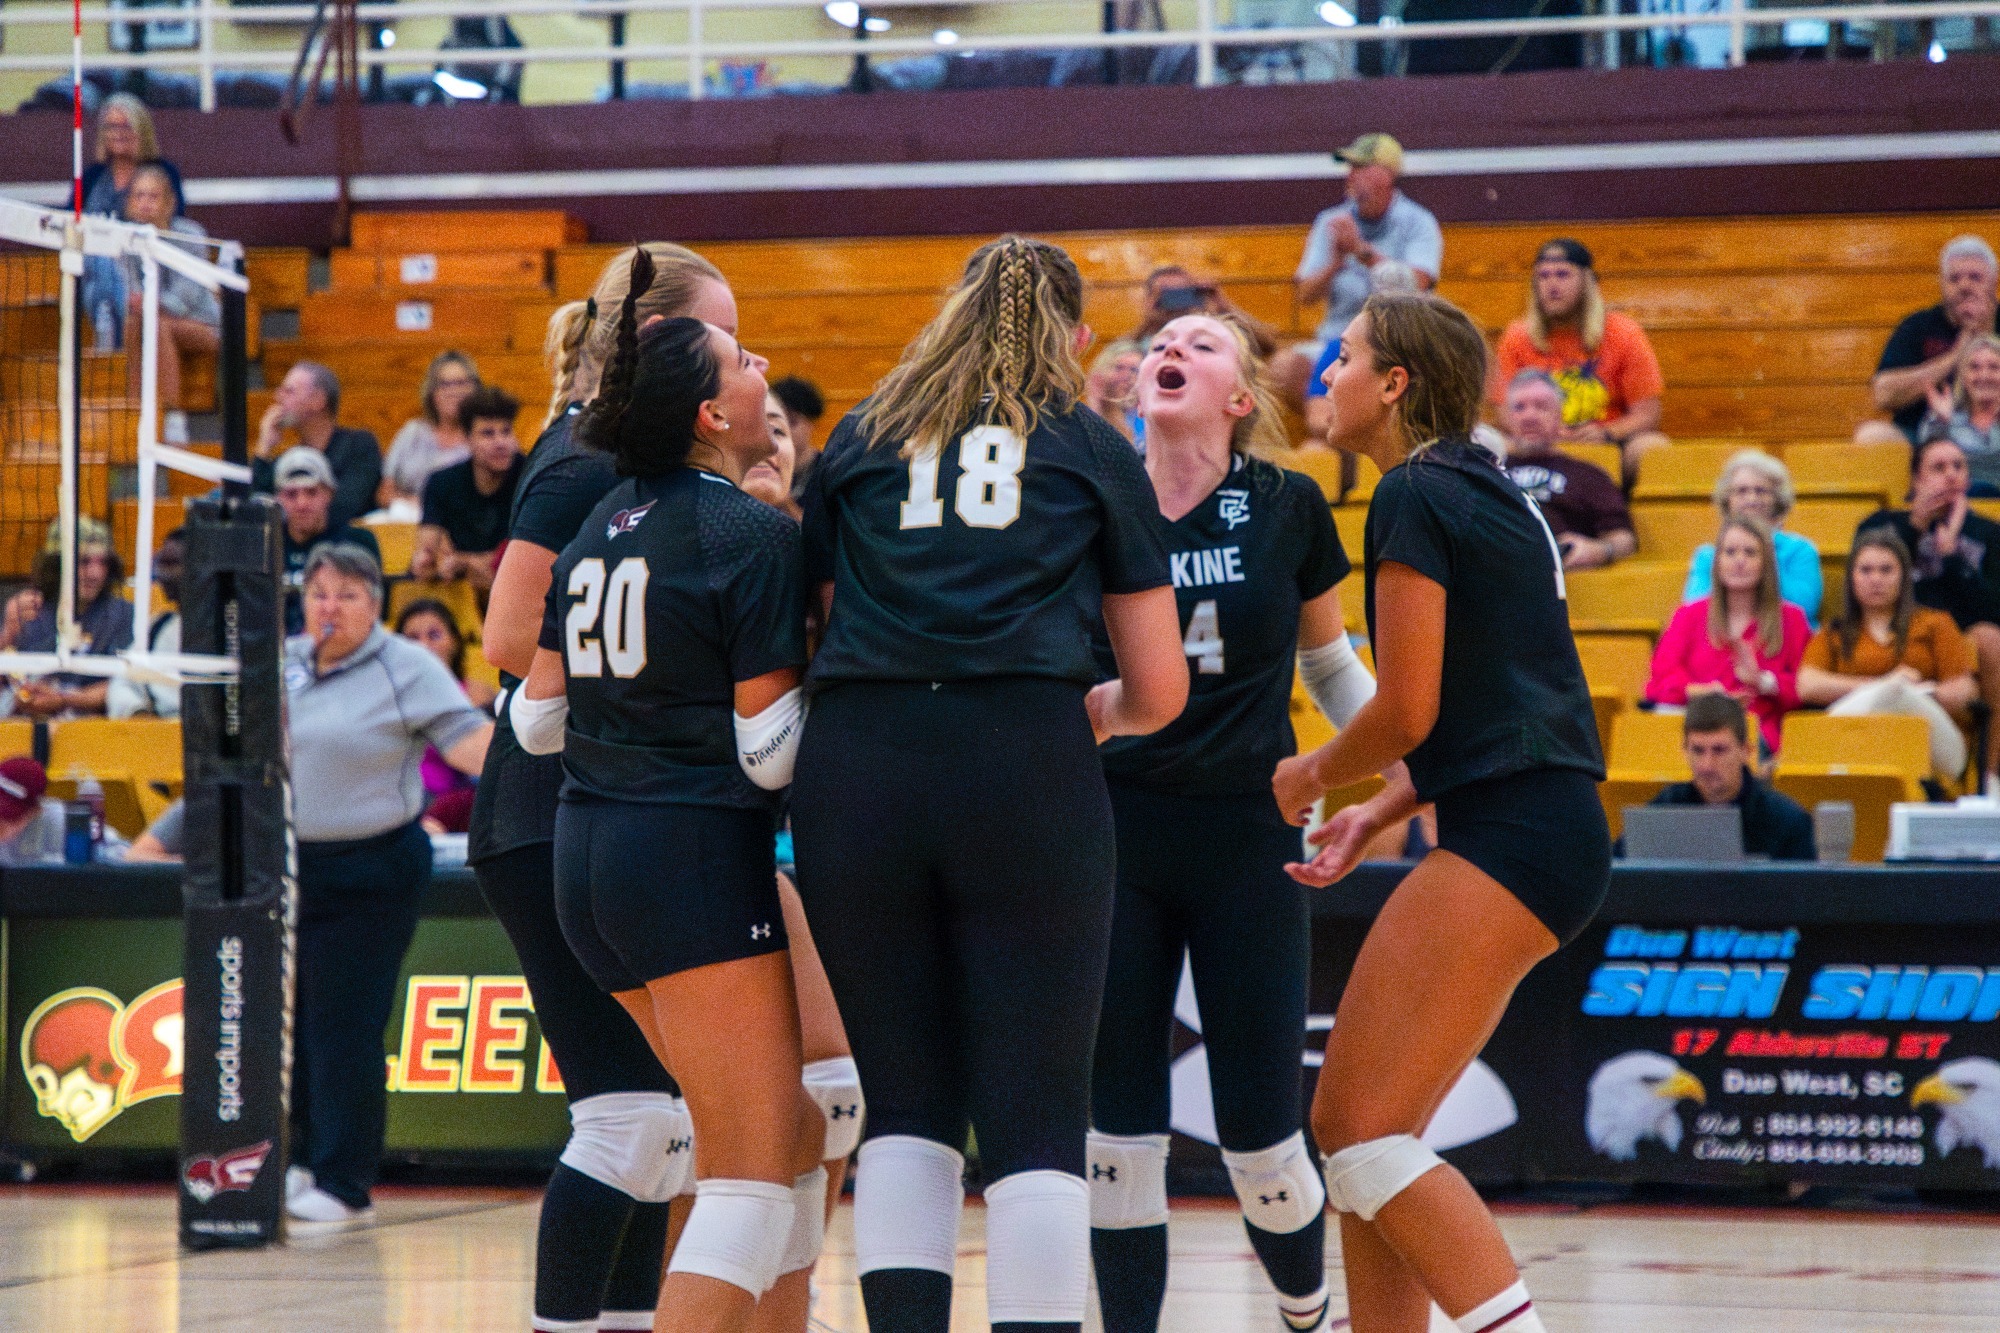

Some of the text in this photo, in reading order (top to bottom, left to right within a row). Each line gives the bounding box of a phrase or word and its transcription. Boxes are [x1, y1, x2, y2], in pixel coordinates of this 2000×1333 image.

[899, 425, 1028, 530] 18
[1170, 546, 1246, 588] KINE
[565, 556, 650, 679] 20
[1182, 599, 1225, 674] 4
[743, 725, 792, 767] Tandem
[1581, 961, 1790, 1019] SIGN
[214, 936, 245, 1122] sports imports
[386, 975, 566, 1093] EE
[1672, 1029, 1719, 1056] 17
[1722, 1068, 1904, 1100] Due West, SC
